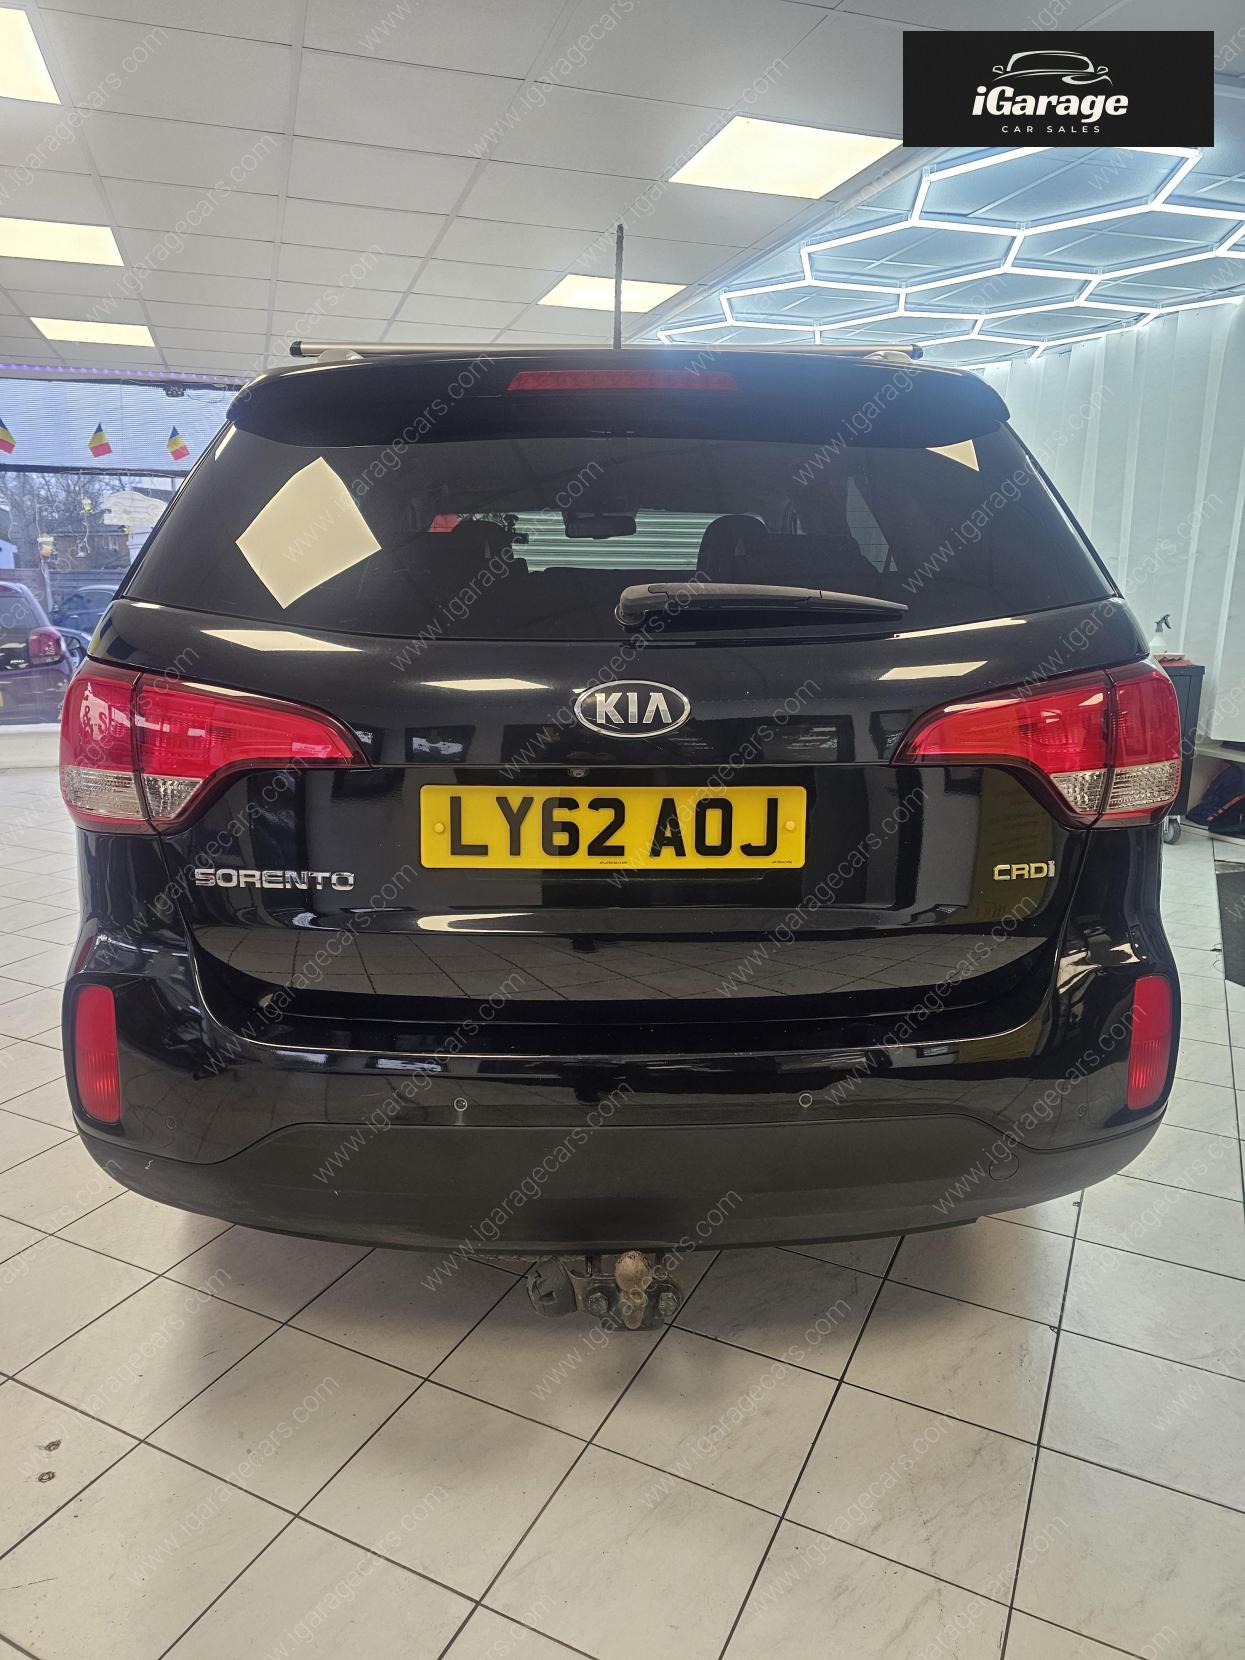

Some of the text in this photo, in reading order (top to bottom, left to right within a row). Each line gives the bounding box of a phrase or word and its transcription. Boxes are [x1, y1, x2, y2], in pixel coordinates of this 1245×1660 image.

[594, 692, 672, 724] KIA
[450, 796, 779, 857] LY62 AOJ
[194, 868, 355, 891] SORENTO
